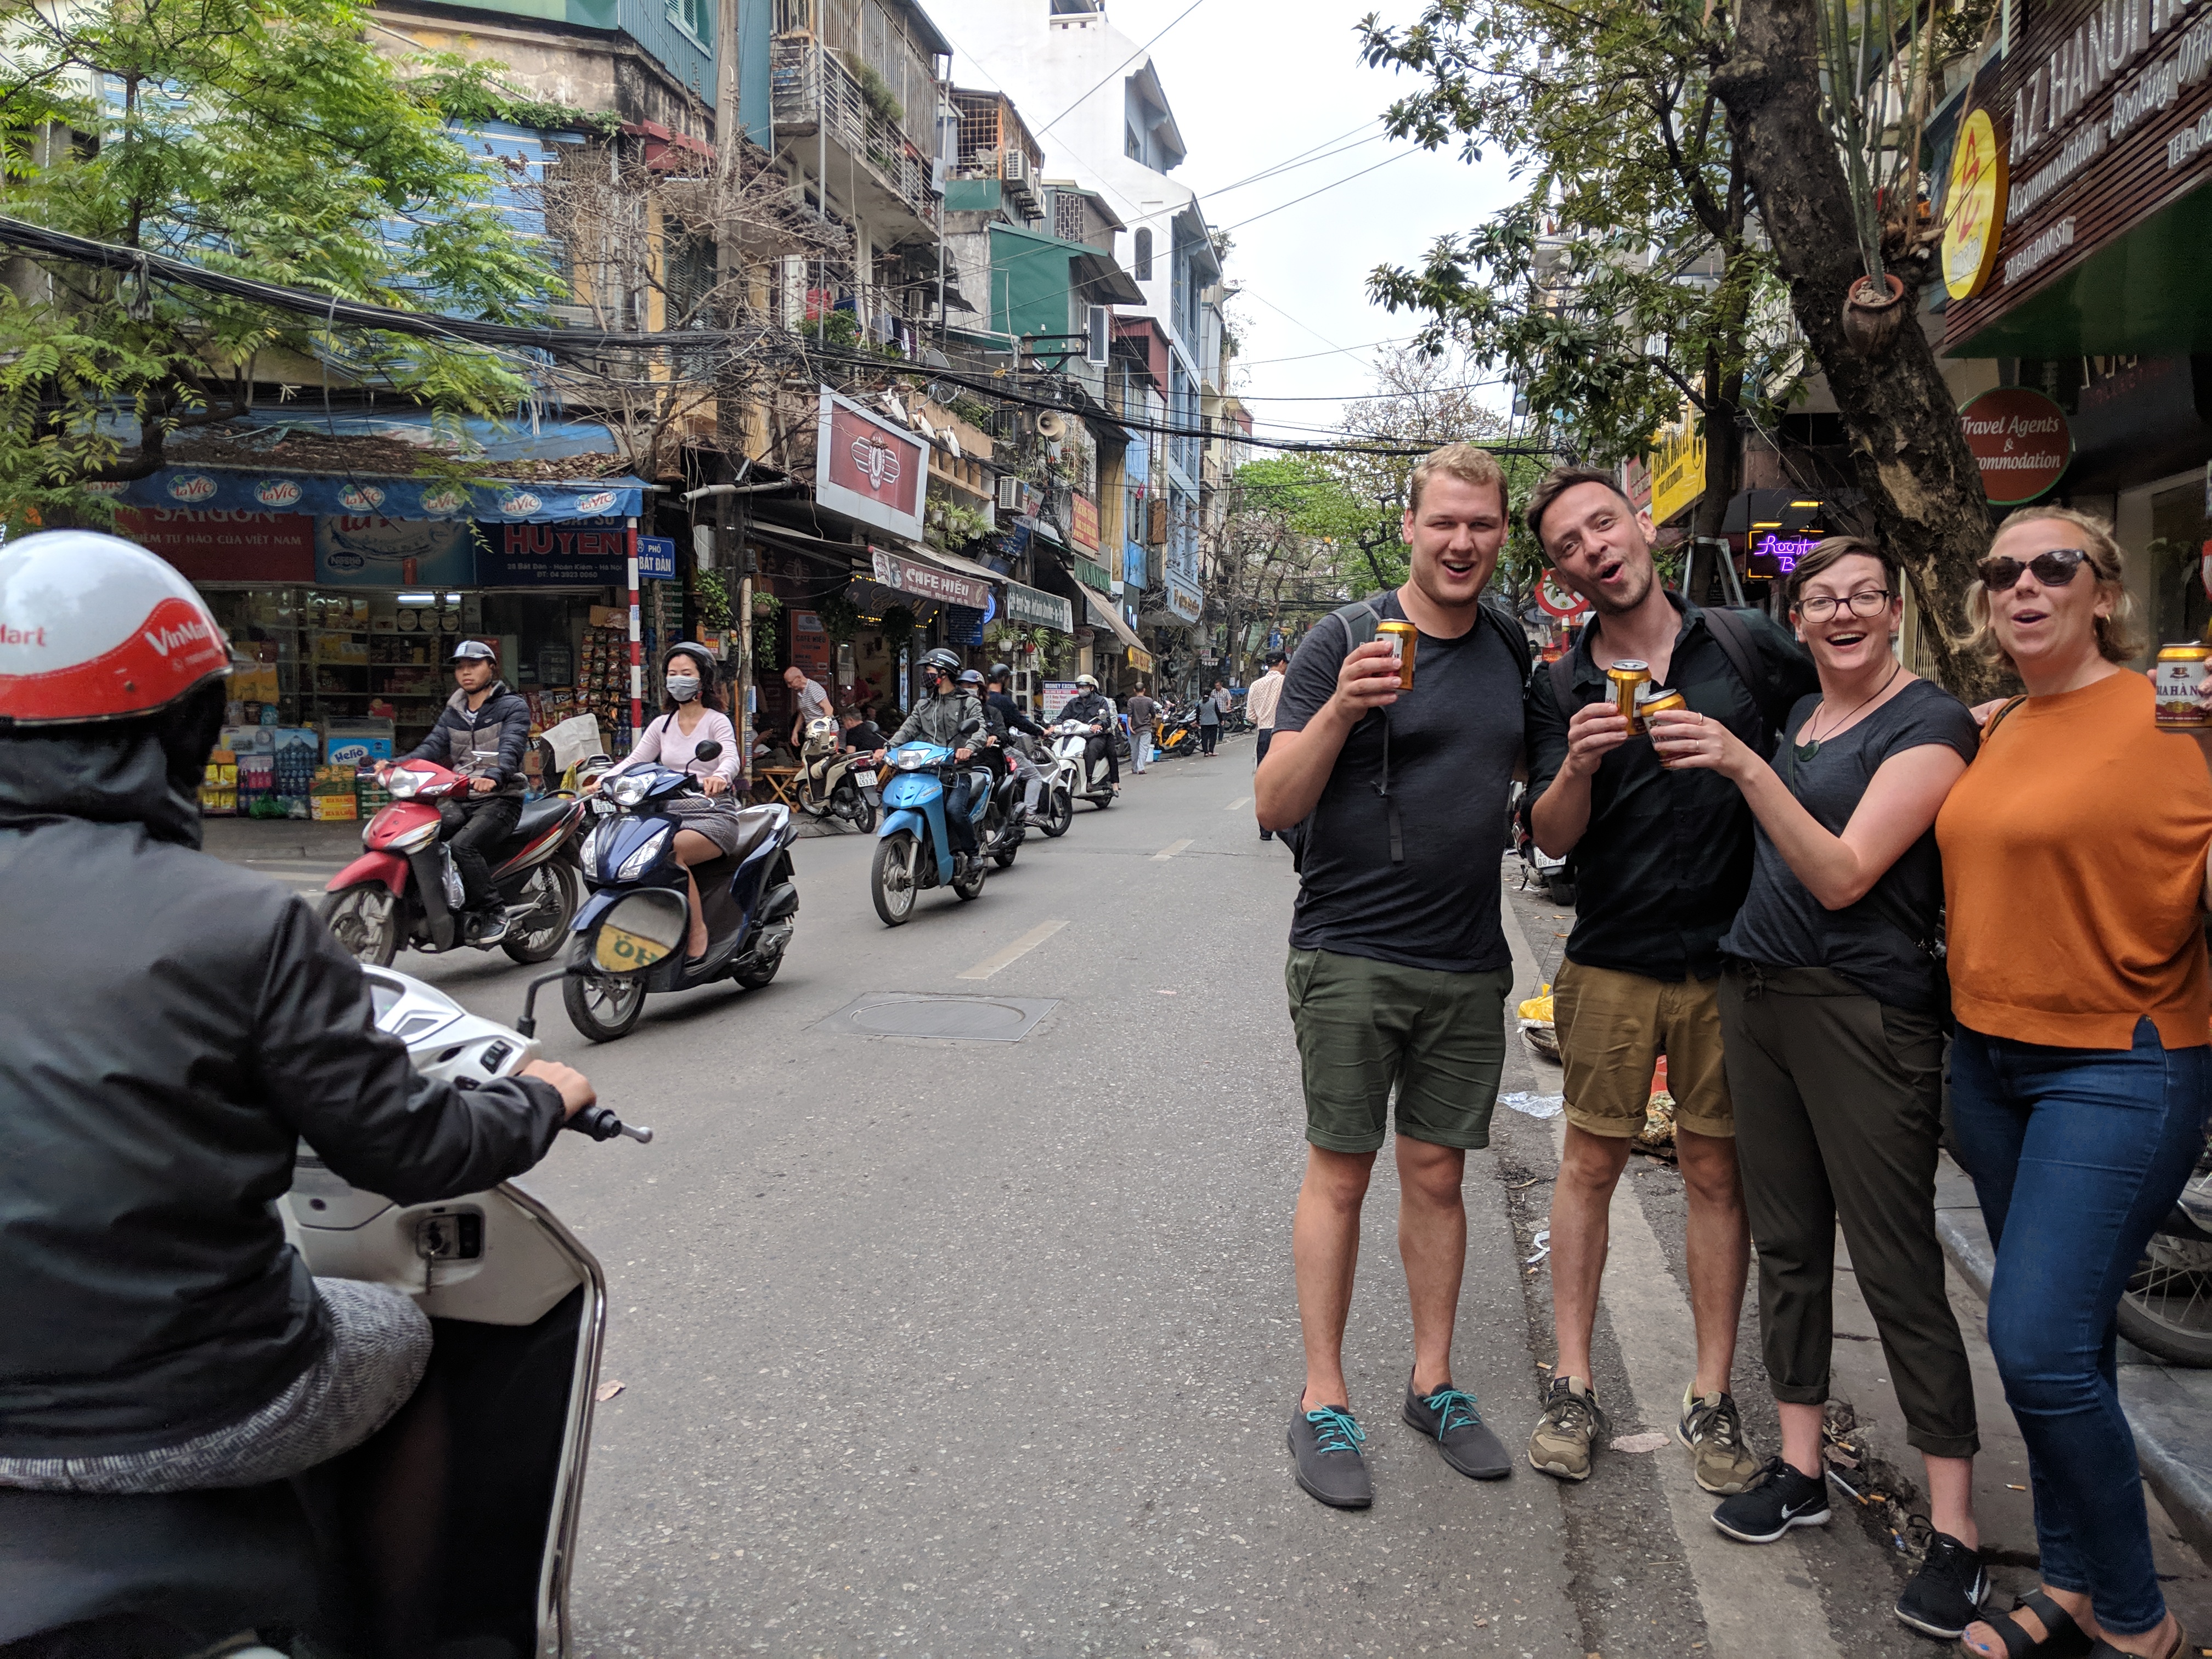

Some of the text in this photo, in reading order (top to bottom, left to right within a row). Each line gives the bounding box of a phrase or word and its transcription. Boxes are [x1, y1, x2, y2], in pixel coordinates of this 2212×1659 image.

[2009, 67, 2041, 165] AZ
[2007, 124, 2099, 224] Accommodation
[2111, 61, 2170, 138] Booking
[1950, 222, 1983, 287] hostel
[2017, 245, 2032, 276] BAT
[2034, 229, 2052, 263] DAN
[2056, 219, 2067, 249] ST
[1961, 415, 2060, 438] Travel Agents
[2003, 438, 2014, 453] &
[274, 535, 301, 546] NAM
[639, 555, 671, 572] BÁT ĐÀN
[906, 568, 939, 589] CAFE
